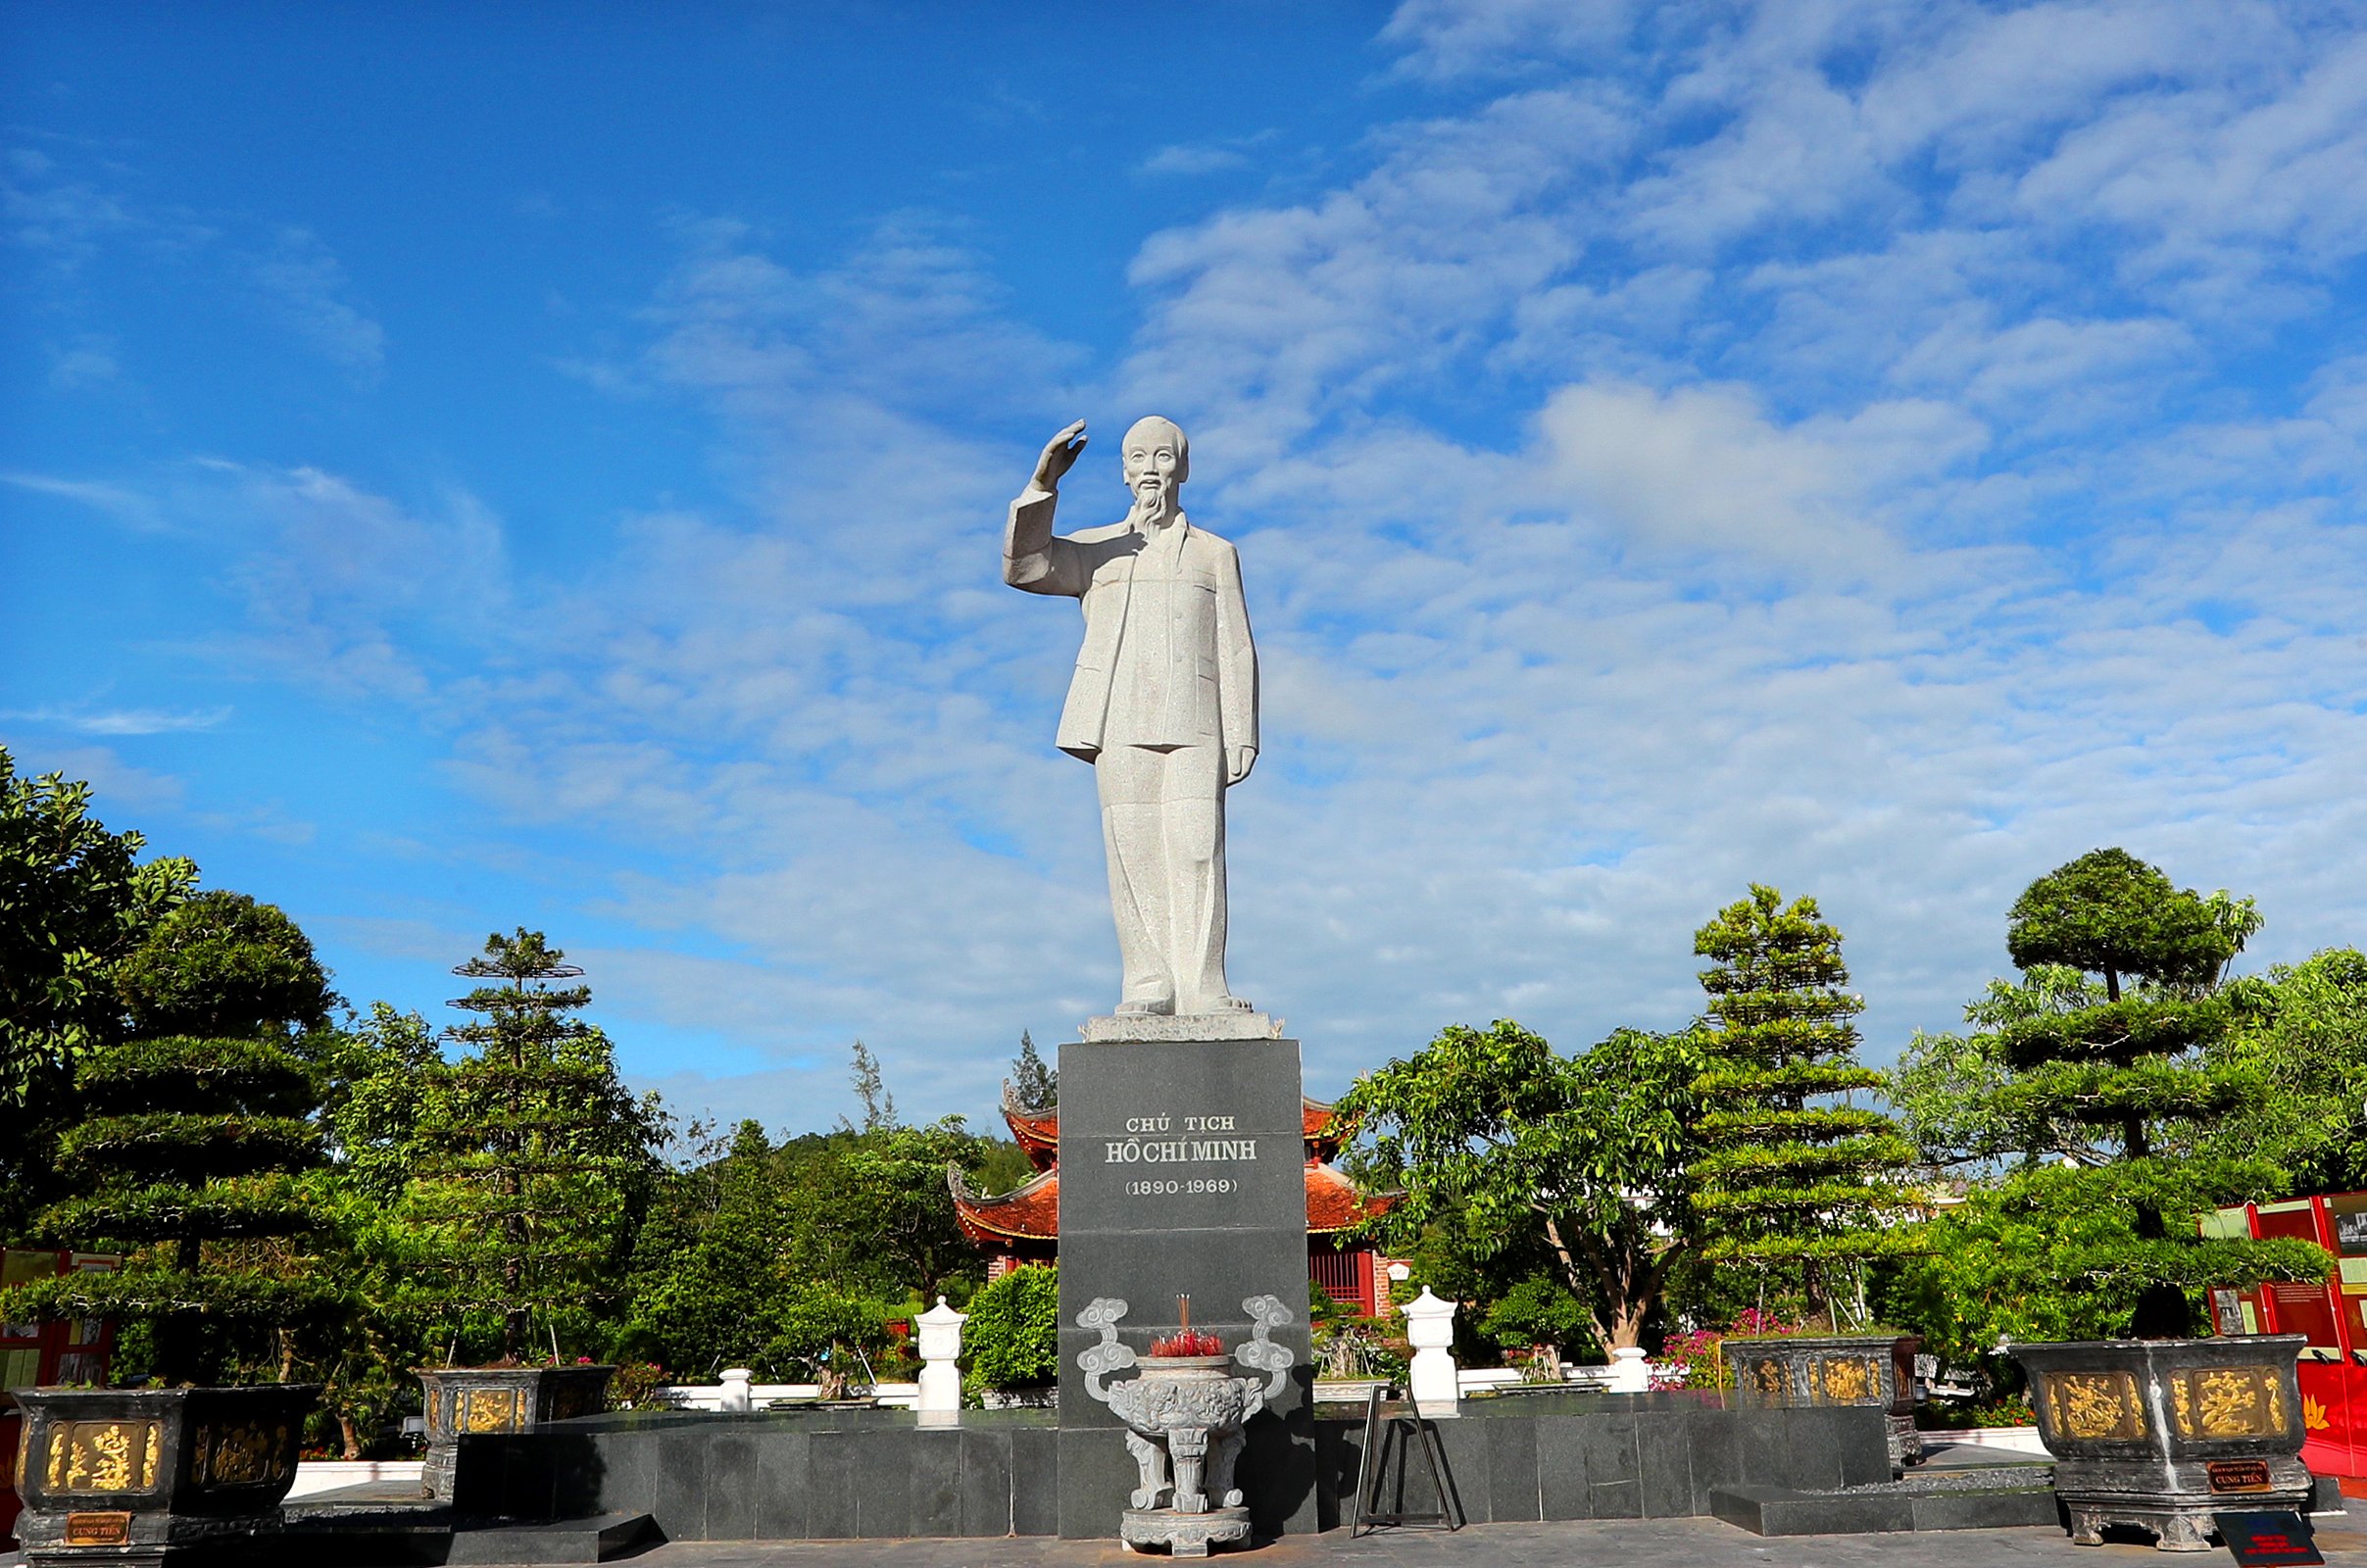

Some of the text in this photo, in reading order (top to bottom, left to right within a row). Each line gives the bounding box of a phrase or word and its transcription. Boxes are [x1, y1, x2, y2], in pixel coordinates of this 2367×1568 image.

[1184, 1115, 1235, 1134] TỊCH
[1105, 1136, 1257, 1163] HỒ CHÍ MINH
[1125, 1179, 1238, 1196] (1890-1969)
